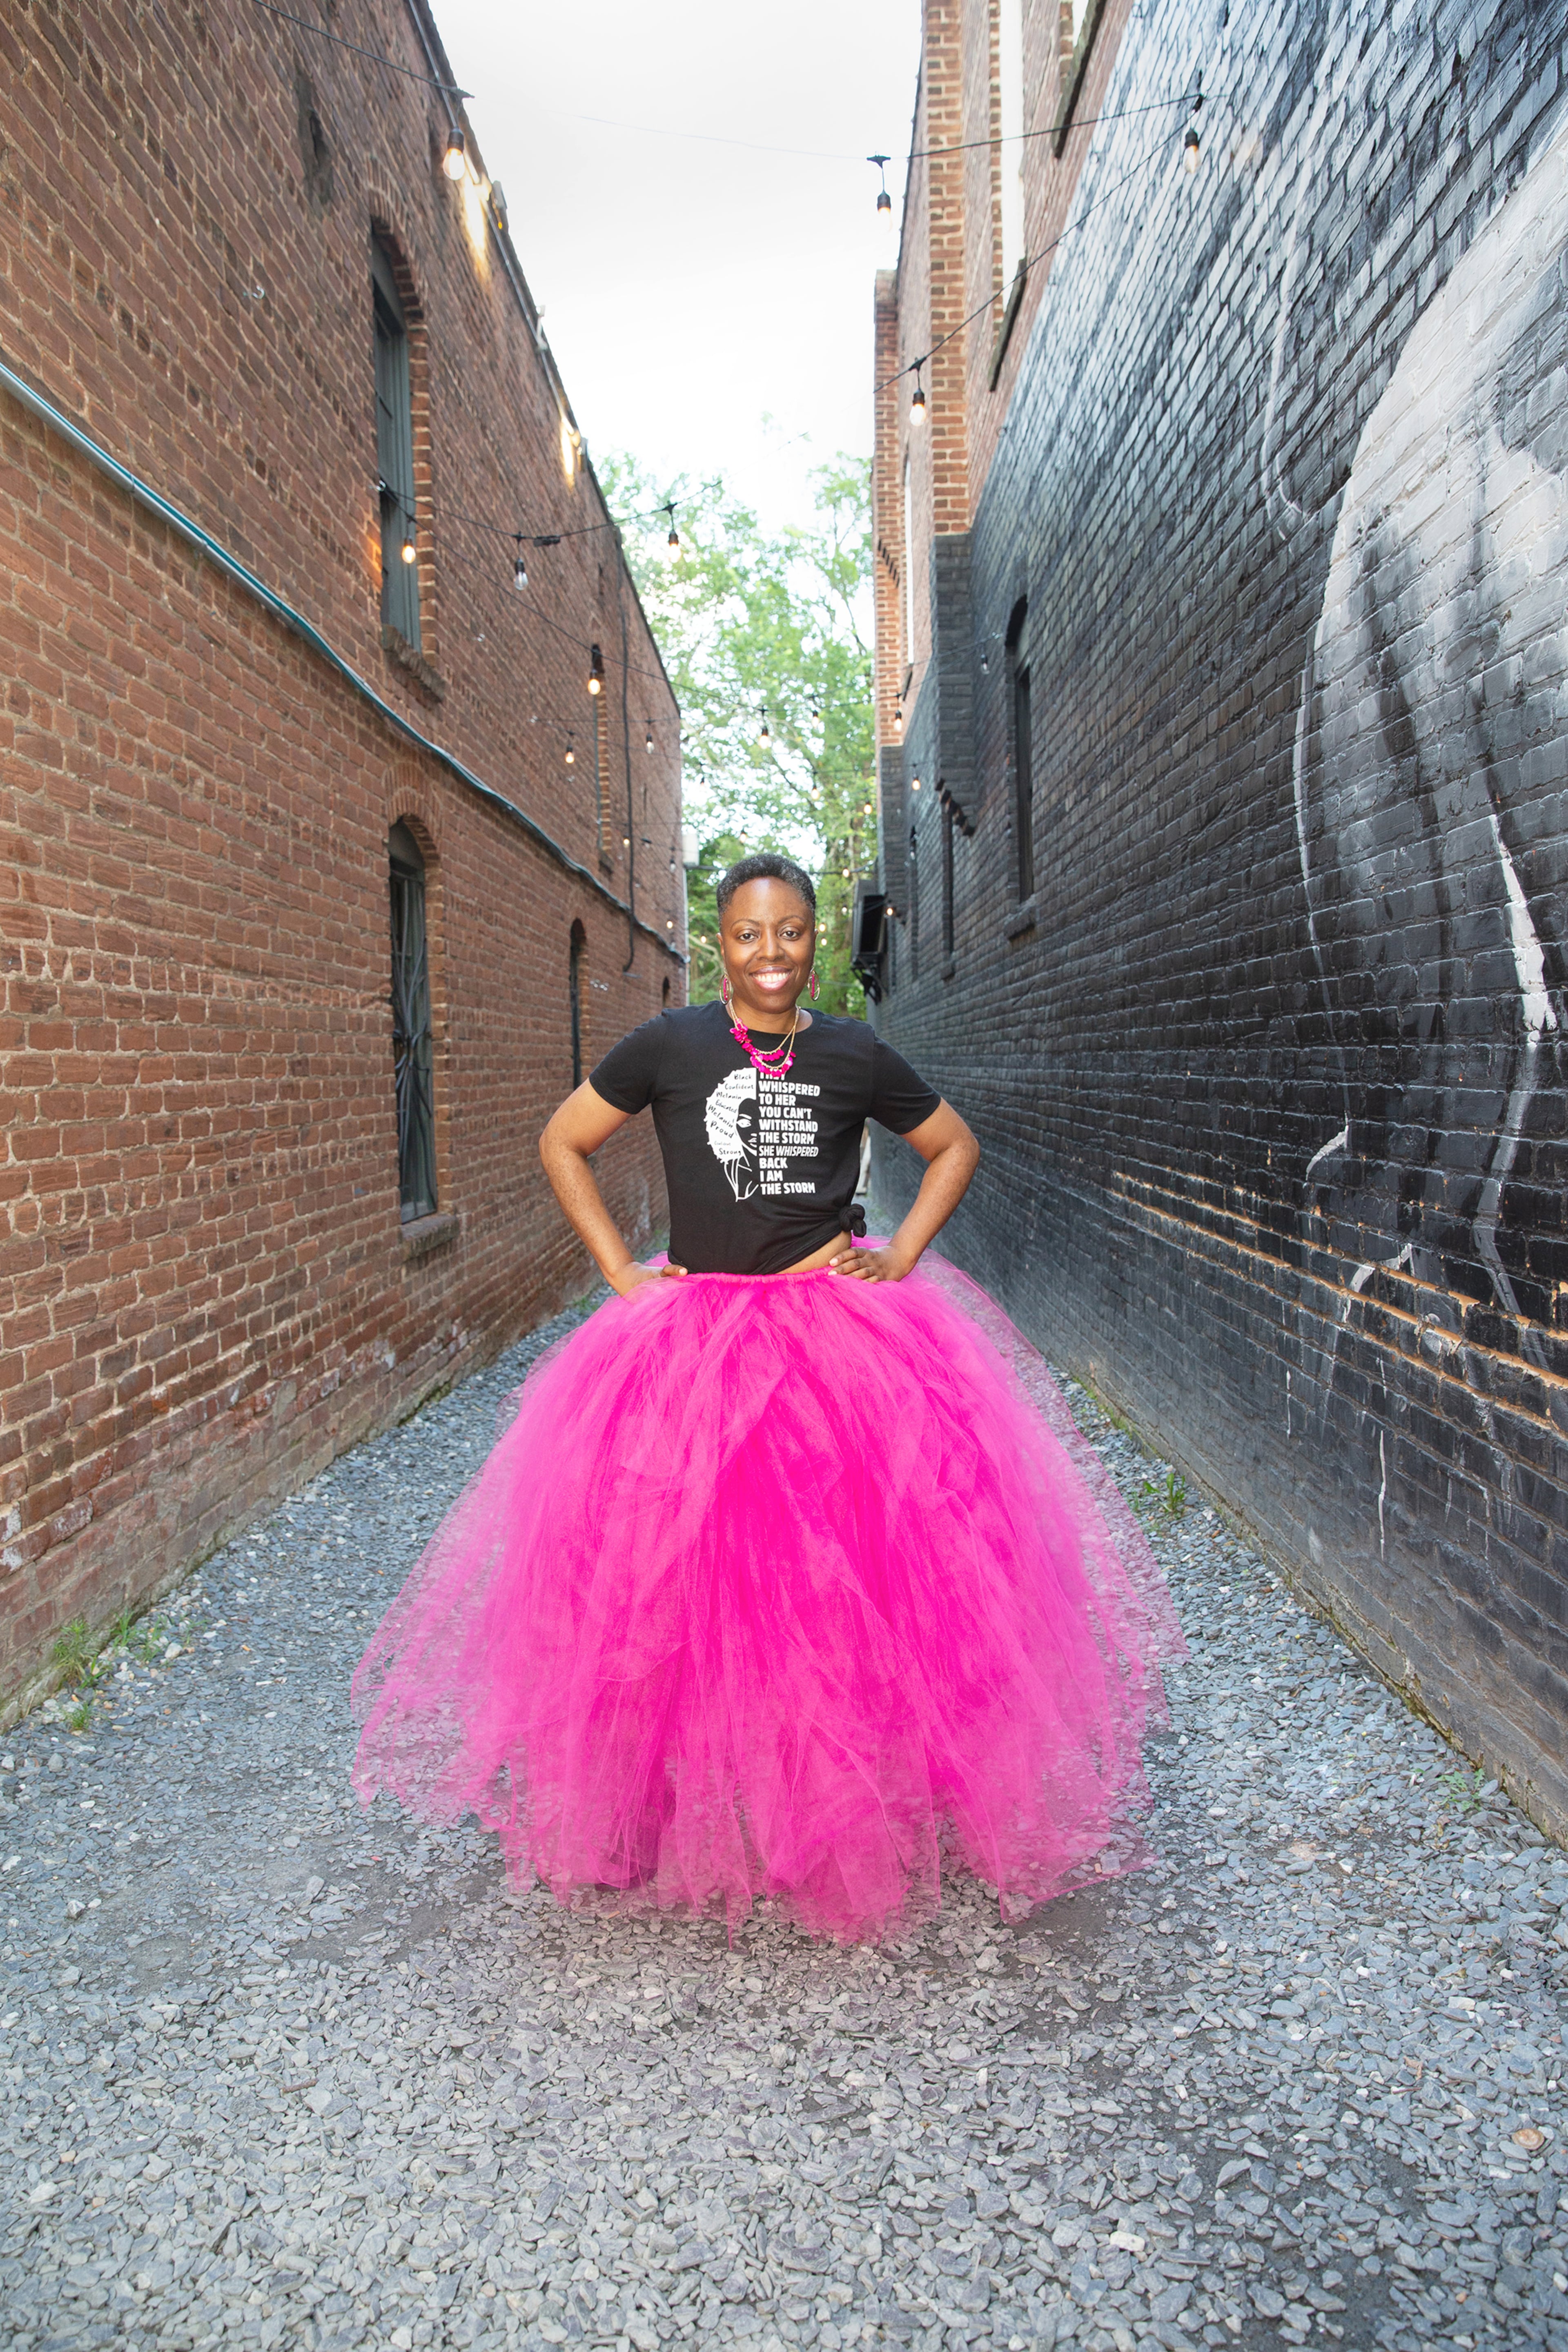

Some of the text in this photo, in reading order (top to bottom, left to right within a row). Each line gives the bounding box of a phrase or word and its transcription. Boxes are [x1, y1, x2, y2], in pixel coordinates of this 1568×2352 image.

[758, 1080, 820, 1097] WHISPERED
[715, 1099, 737, 1113] Educated
[758, 1093, 796, 1106] TO HER
[708, 1105, 733, 1128] Melanin
[758, 1106, 812, 1120] YOU CAN'T
[710, 1120, 734, 1138] Proud
[758, 1119, 818, 1132] WITHSTAND
[759, 1132, 815, 1145] THE STORM
[759, 1145, 819, 1157] SHE WHISPERED
[759, 1157, 788, 1169] BACK
[760, 1170, 783, 1182] I AM
[760, 1182, 816, 1195] THE STORM
